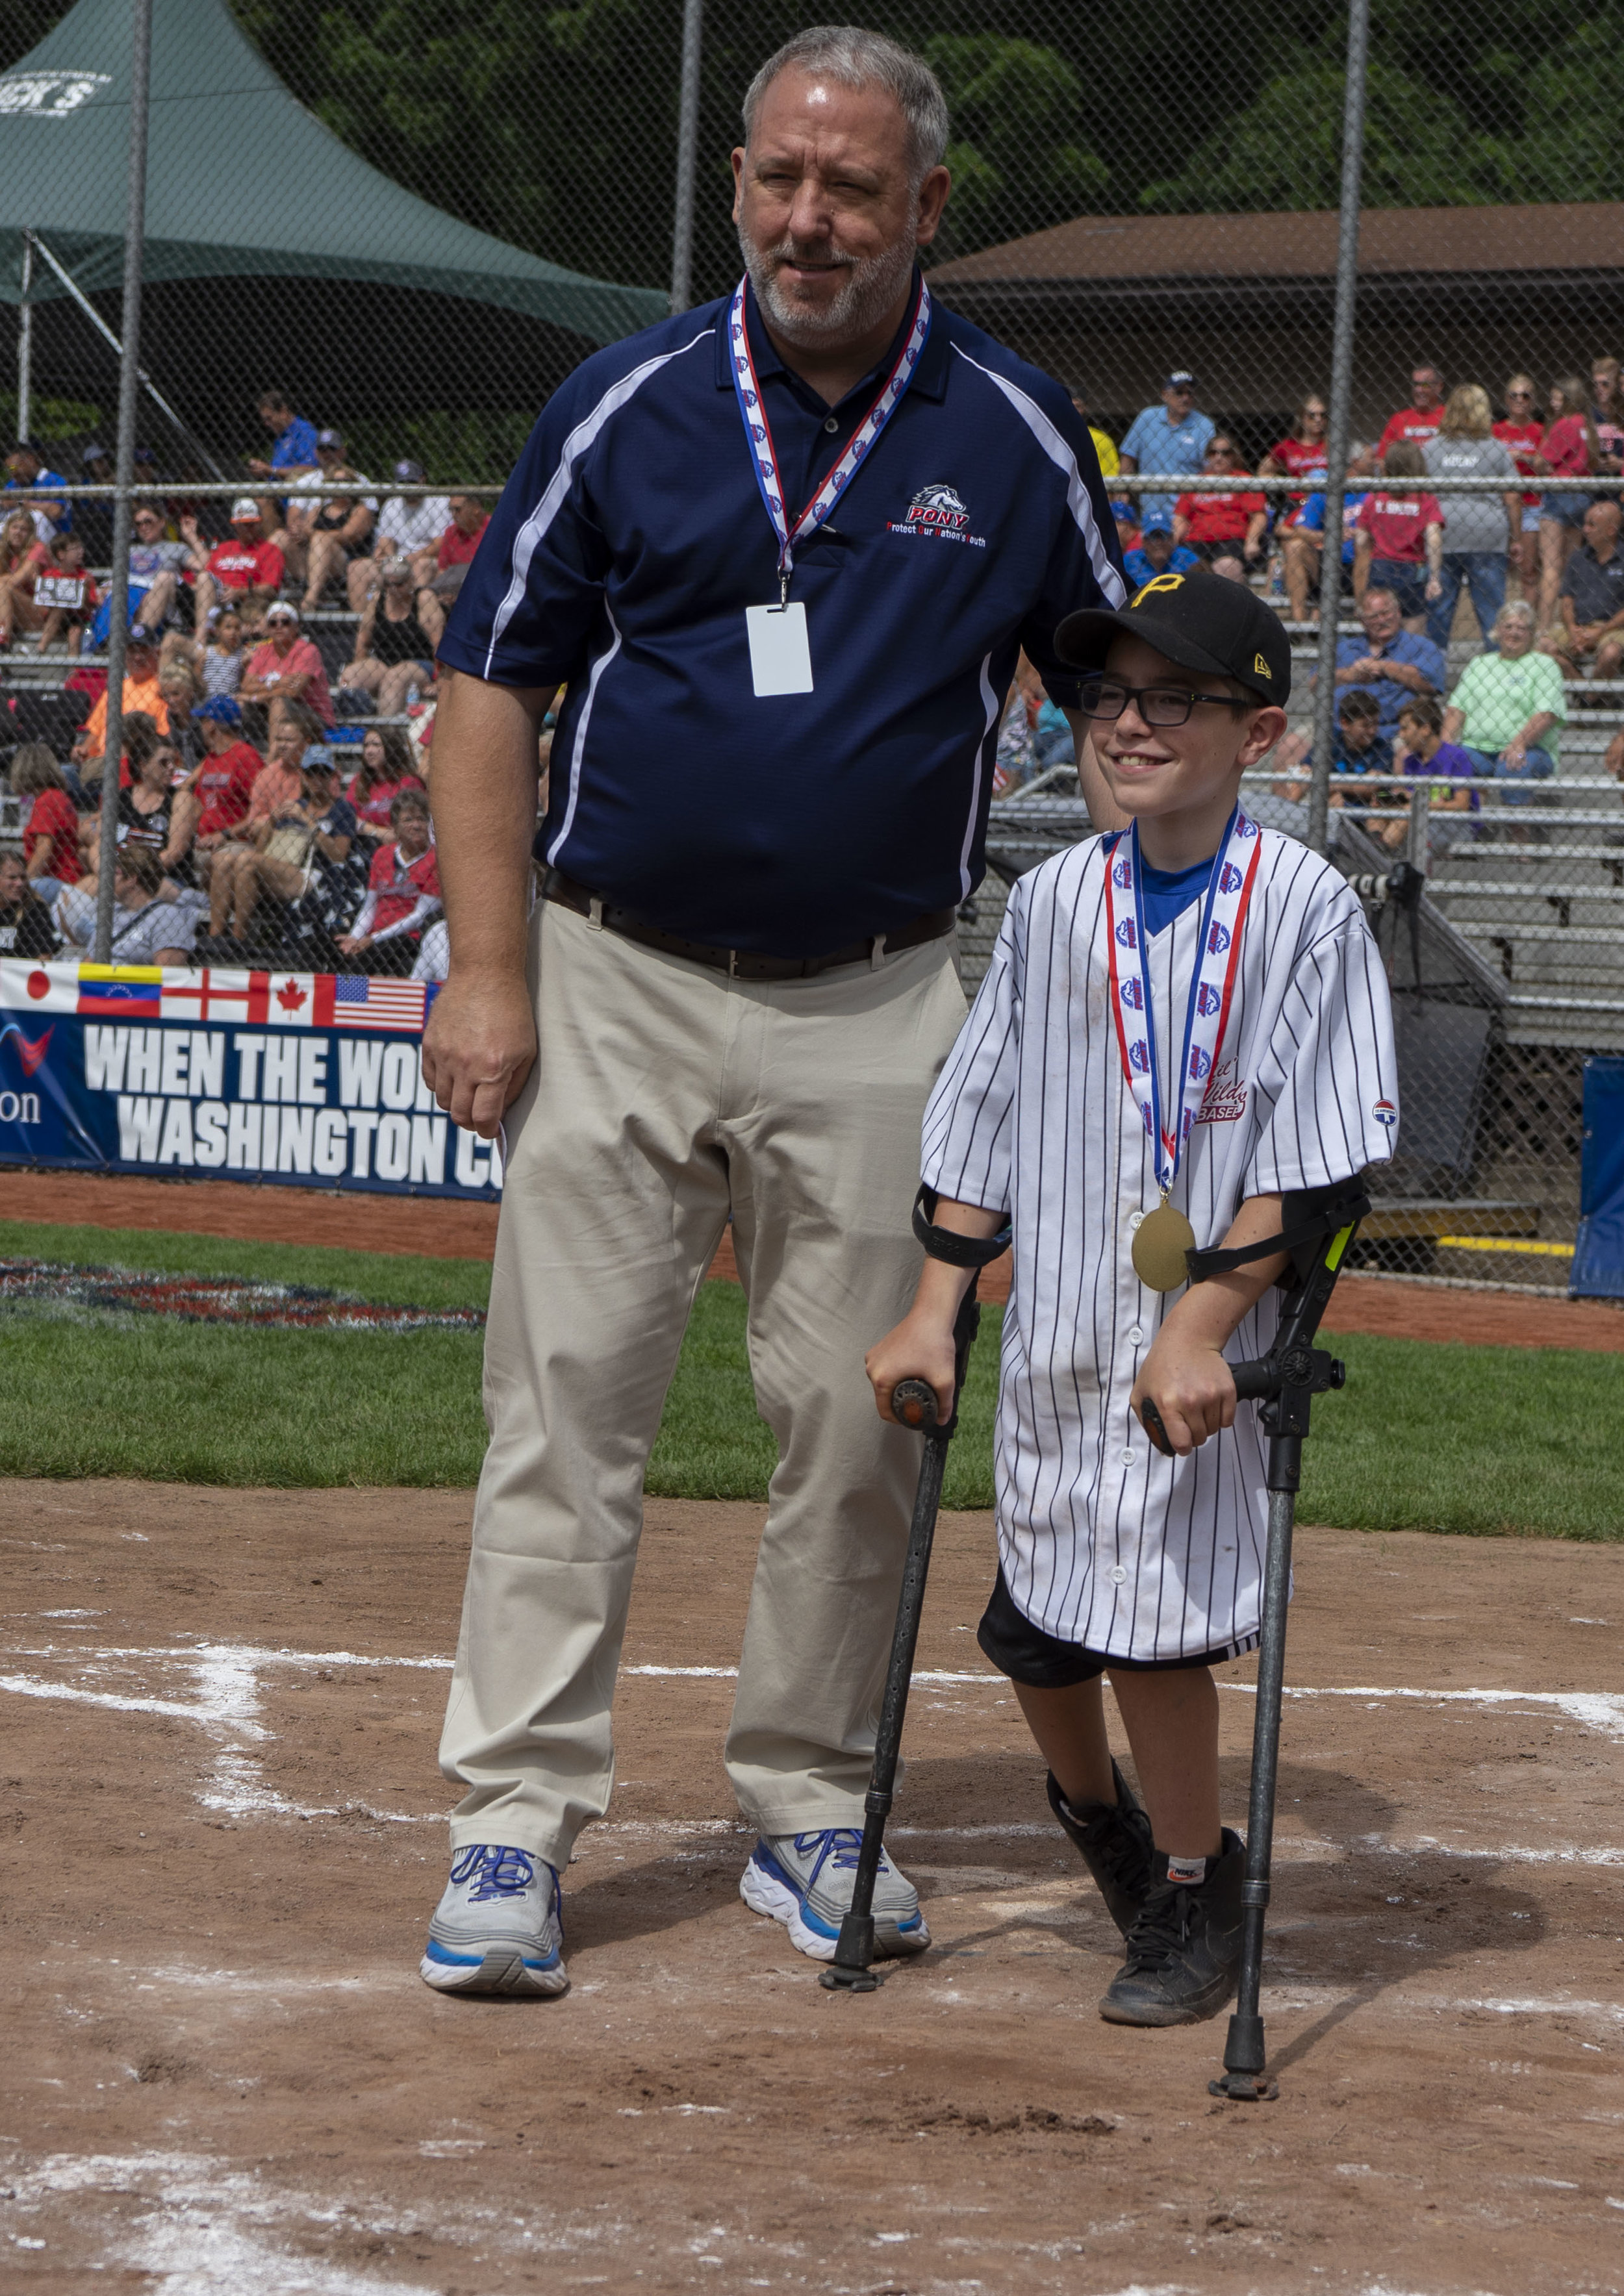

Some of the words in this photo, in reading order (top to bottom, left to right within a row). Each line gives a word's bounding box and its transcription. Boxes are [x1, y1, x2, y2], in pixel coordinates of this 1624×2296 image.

[906, 505, 969, 529] PONY
[887, 522, 916, 534] Protect
[918, 525, 933, 536] Our
[935, 527, 966, 542] Nation's
[966, 533, 986, 548] Youth
[1130, 574, 1186, 609] P
[1123, 860, 1132, 889] PONY
[1219, 861, 1233, 894] PONY
[1126, 917, 1137, 949] PONY
[1207, 920, 1221, 955] PONY
[1132, 977, 1143, 1011] PONY
[1196, 981, 1209, 1017] PONY
[84, 1024, 225, 1098] WHEN
[234, 1033, 329, 1105] THE
[1138, 1039, 1150, 1073] PONY
[1189, 1044, 1200, 1080] PONY
[118, 1094, 448, 1185] WASHINGTON
